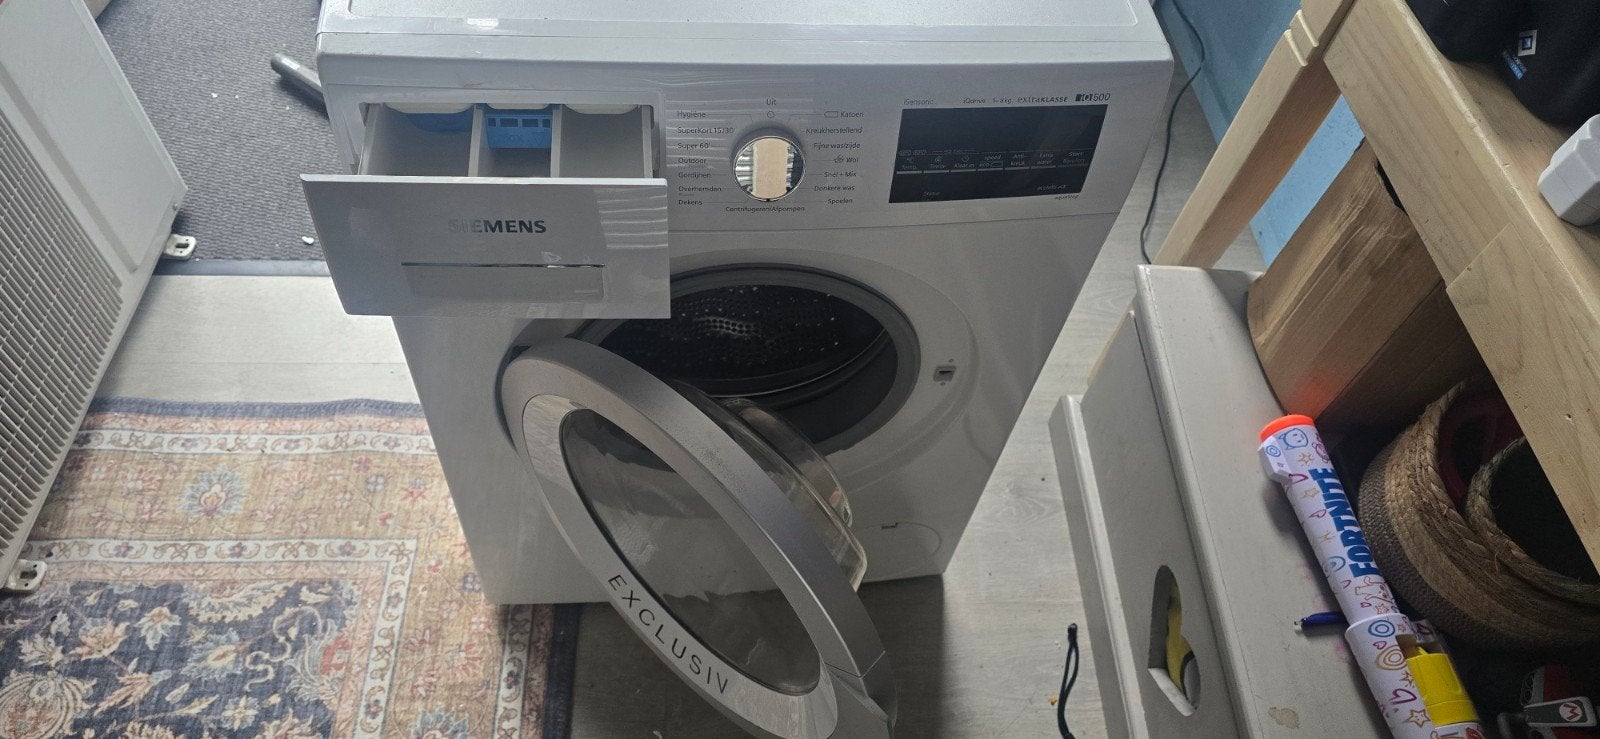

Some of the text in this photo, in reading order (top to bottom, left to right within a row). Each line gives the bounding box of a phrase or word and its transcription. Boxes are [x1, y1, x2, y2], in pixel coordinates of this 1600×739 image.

[766, 98, 777, 106] Uit
[677, 142, 698, 150] Super
[813, 142, 830, 151] Fijne
[678, 171, 712, 179] Gordijnen
[1307, 467, 1383, 578] FORTNITE
[607, 573, 729, 695] EXCLUSIV
